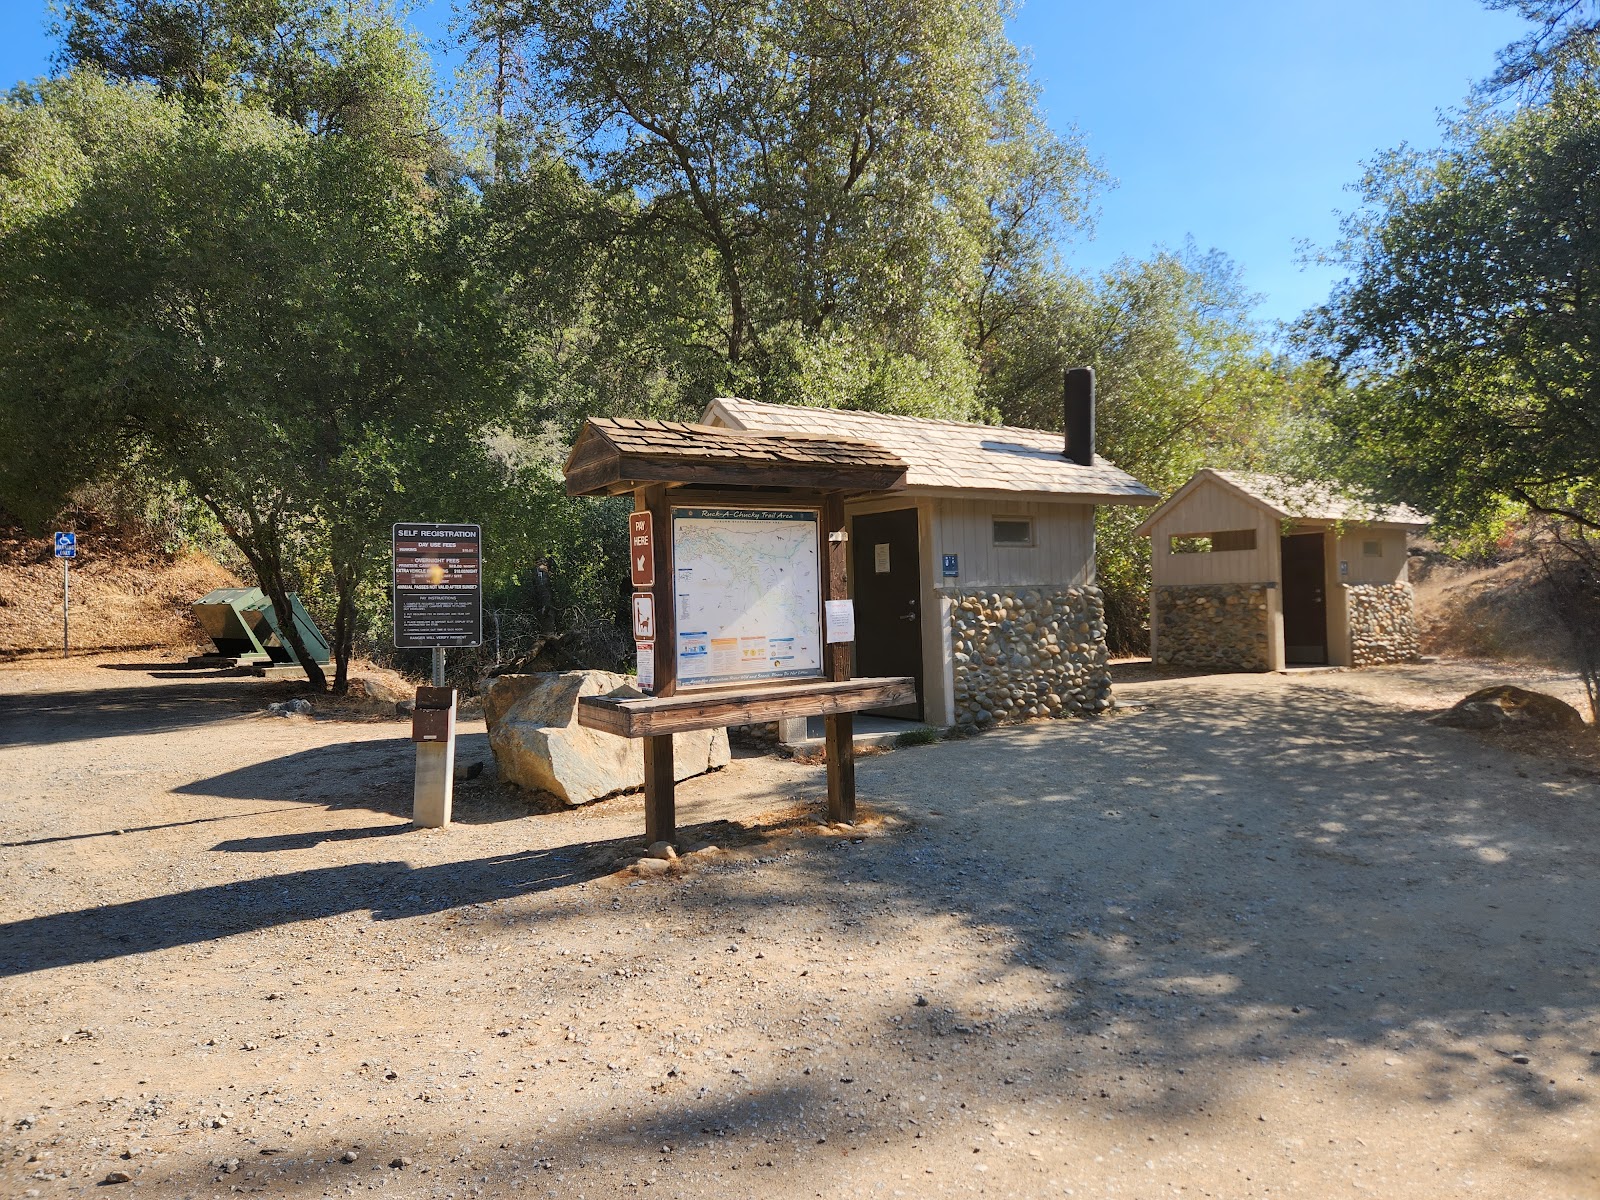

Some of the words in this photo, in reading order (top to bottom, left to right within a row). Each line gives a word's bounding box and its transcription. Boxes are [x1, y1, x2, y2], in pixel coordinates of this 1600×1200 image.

[701, 510, 760, 519] Ruck-A-Chucky
[636, 521, 645, 531] PAY
[634, 536, 648, 546] HERE
